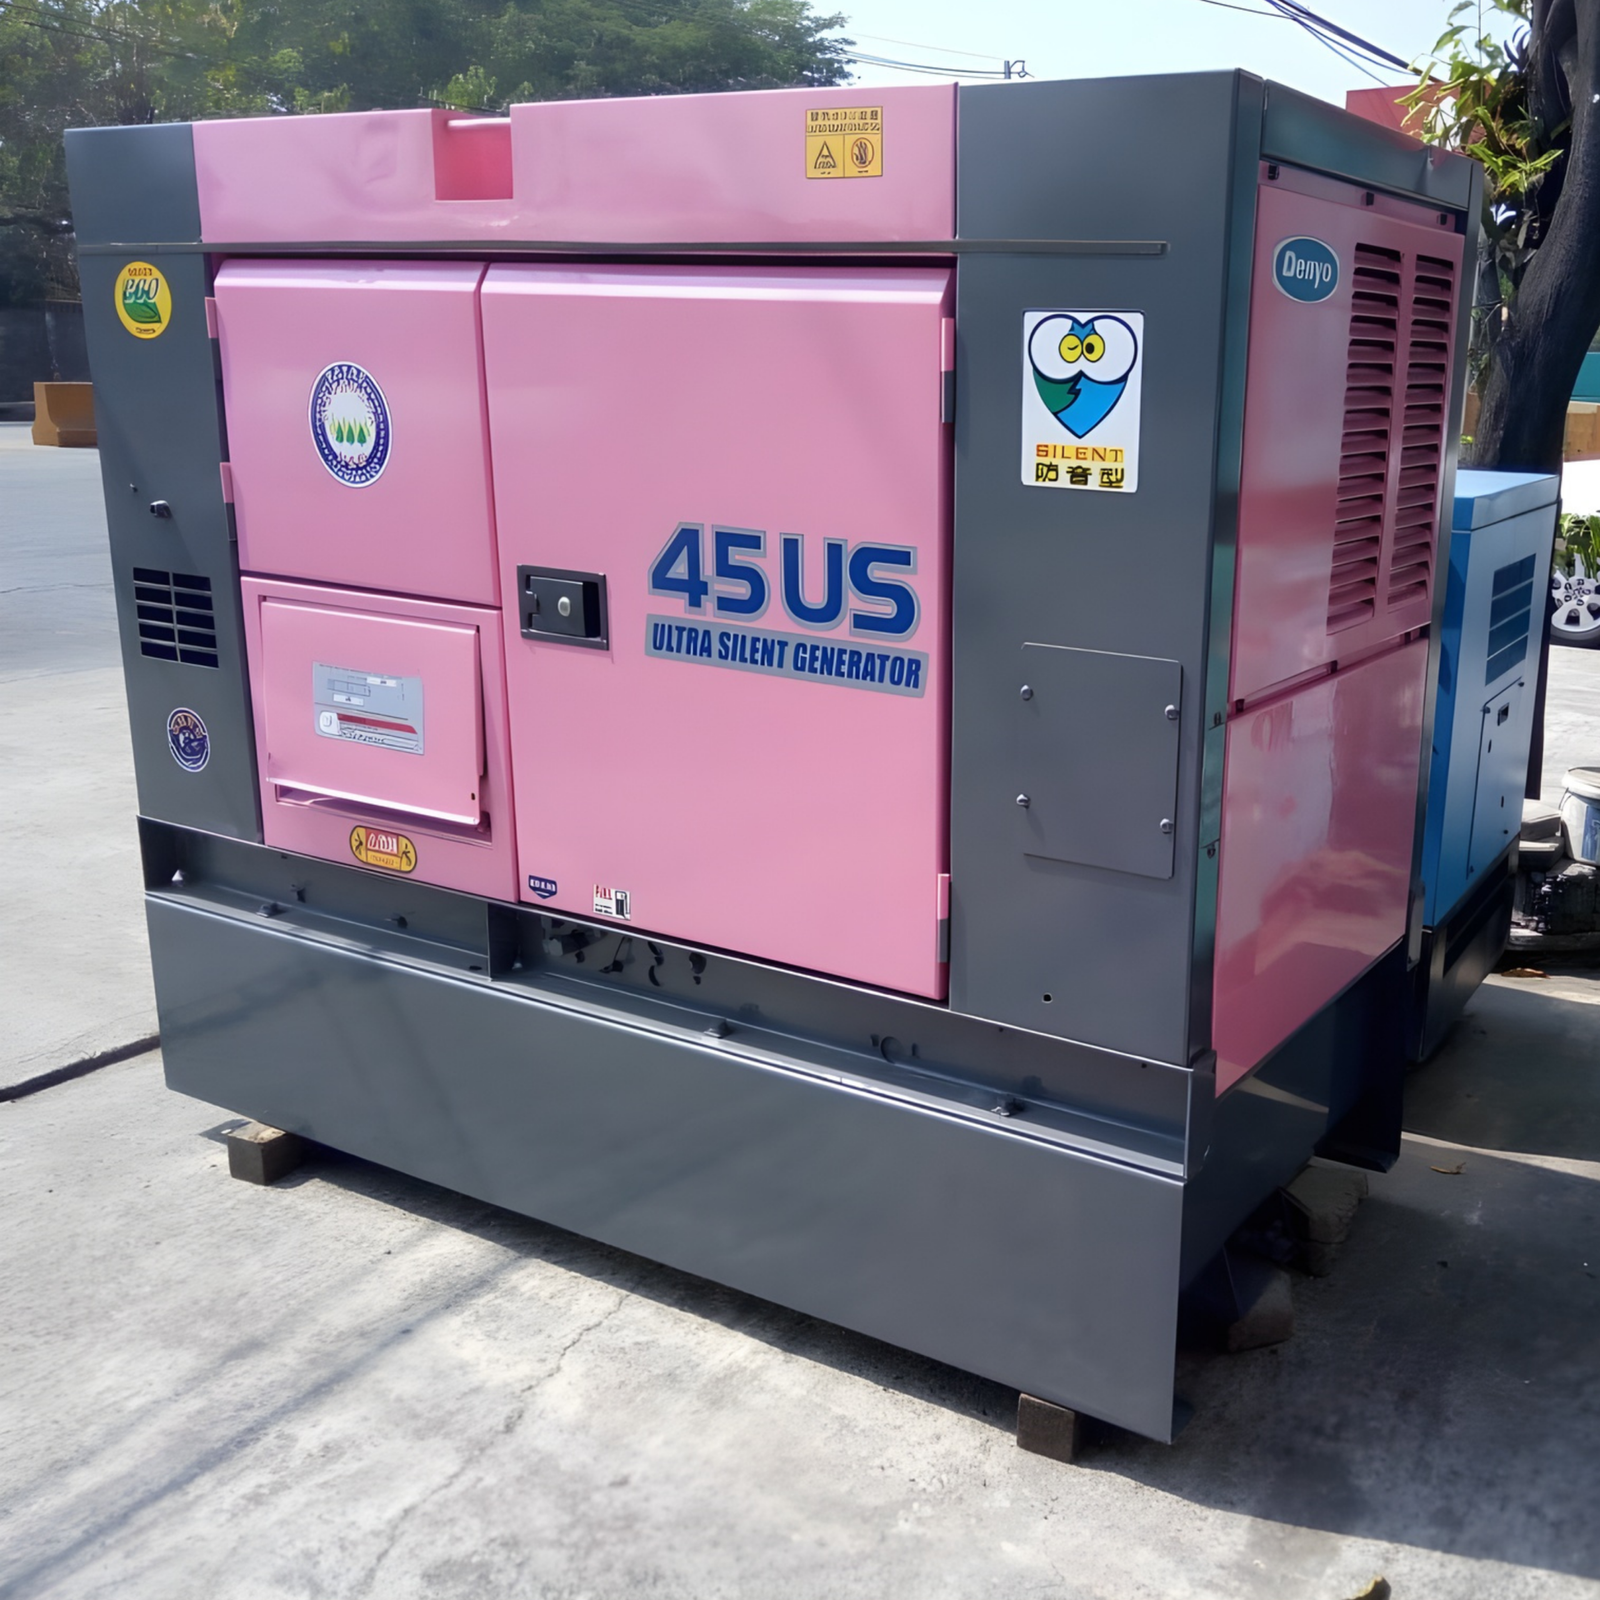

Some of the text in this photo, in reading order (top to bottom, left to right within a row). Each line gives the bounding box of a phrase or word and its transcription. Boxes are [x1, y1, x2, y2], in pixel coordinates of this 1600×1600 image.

[1282, 250, 1332, 289] Denyo
[1036, 444, 1124, 463] SILENT
[1035, 461, 1125, 489] 防音型
[653, 623, 922, 689] ULTRA SILENT GENERATOR
